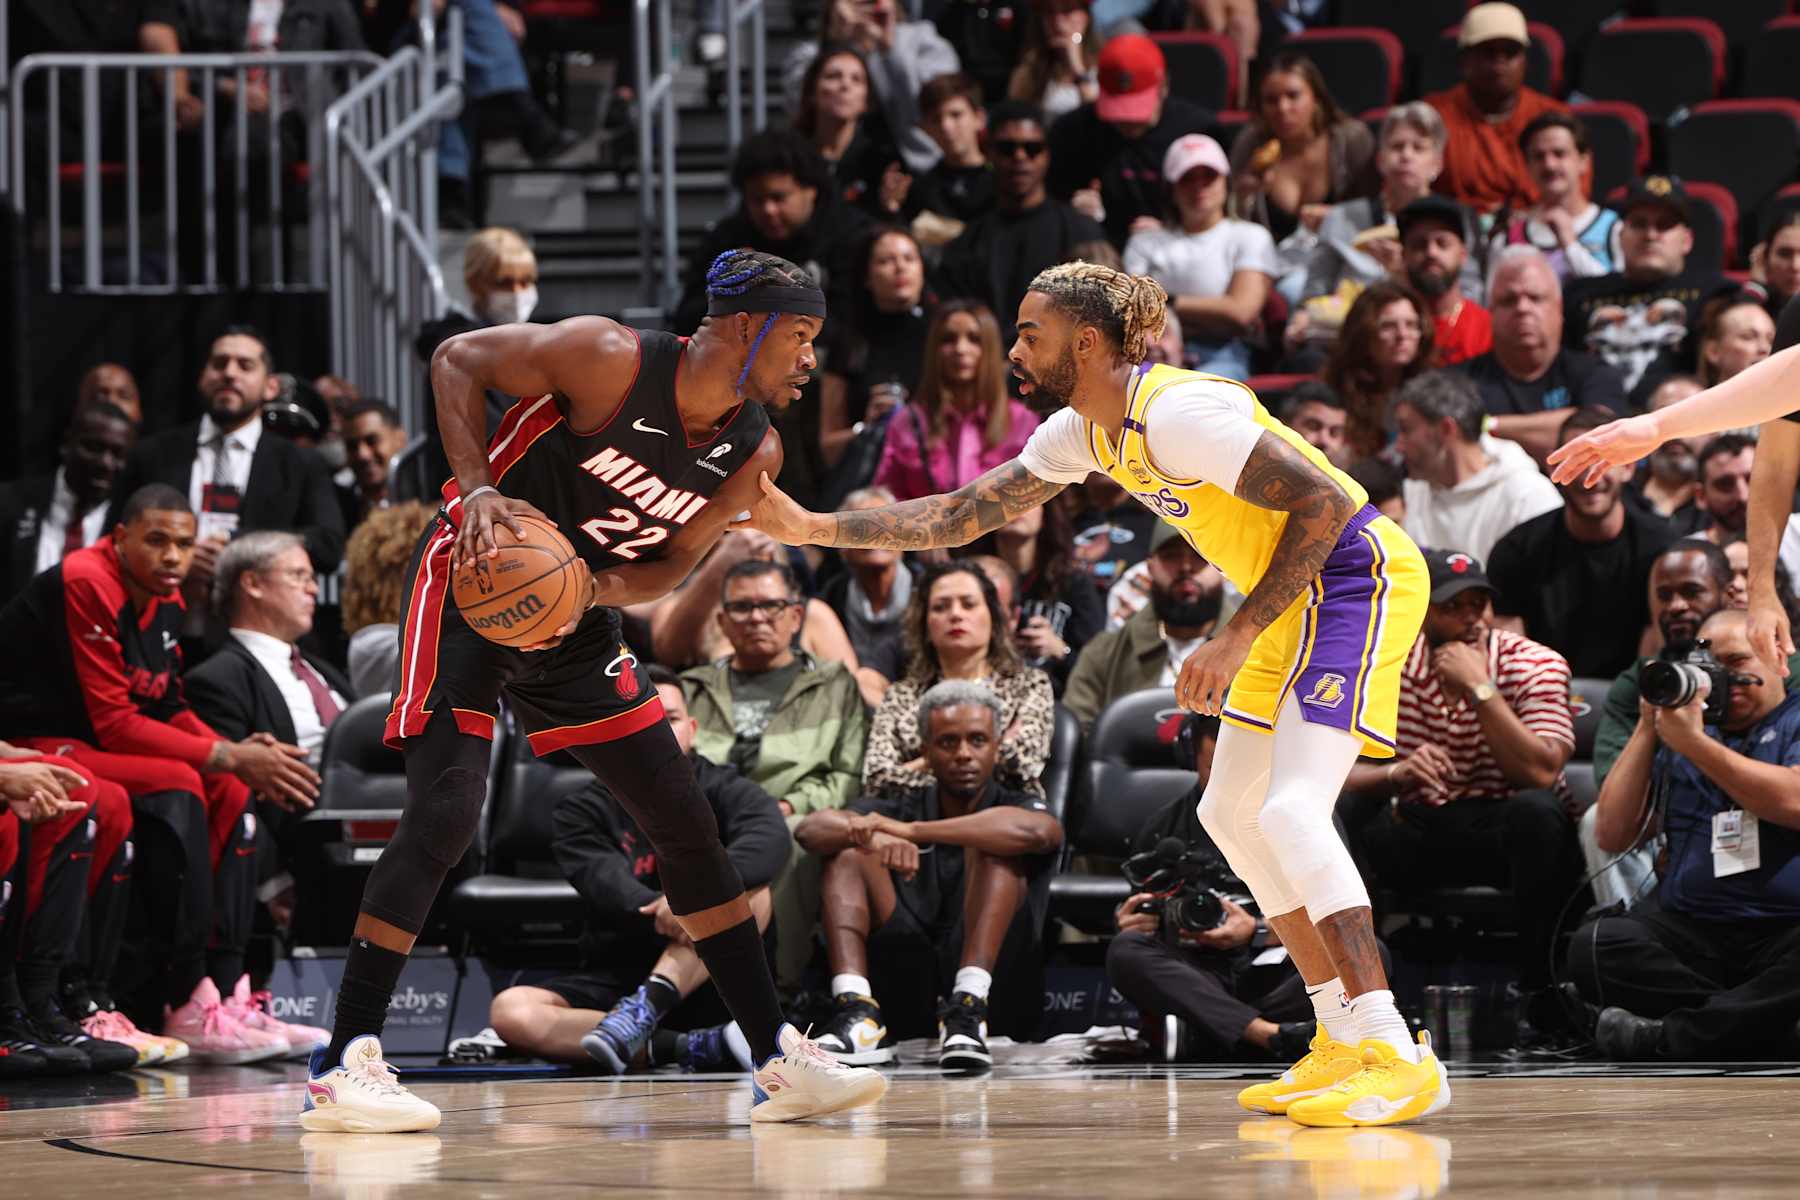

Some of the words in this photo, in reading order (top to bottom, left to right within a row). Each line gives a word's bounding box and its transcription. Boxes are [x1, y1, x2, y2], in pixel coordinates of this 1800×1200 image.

[579, 446, 709, 526] MIAMI
[696, 458, 728, 478] robinhood
[578, 507, 671, 561] 22
[468, 593, 547, 630] Wilson
[271, 996, 317, 1018] ONE
[390, 986, 449, 1014] eby's
